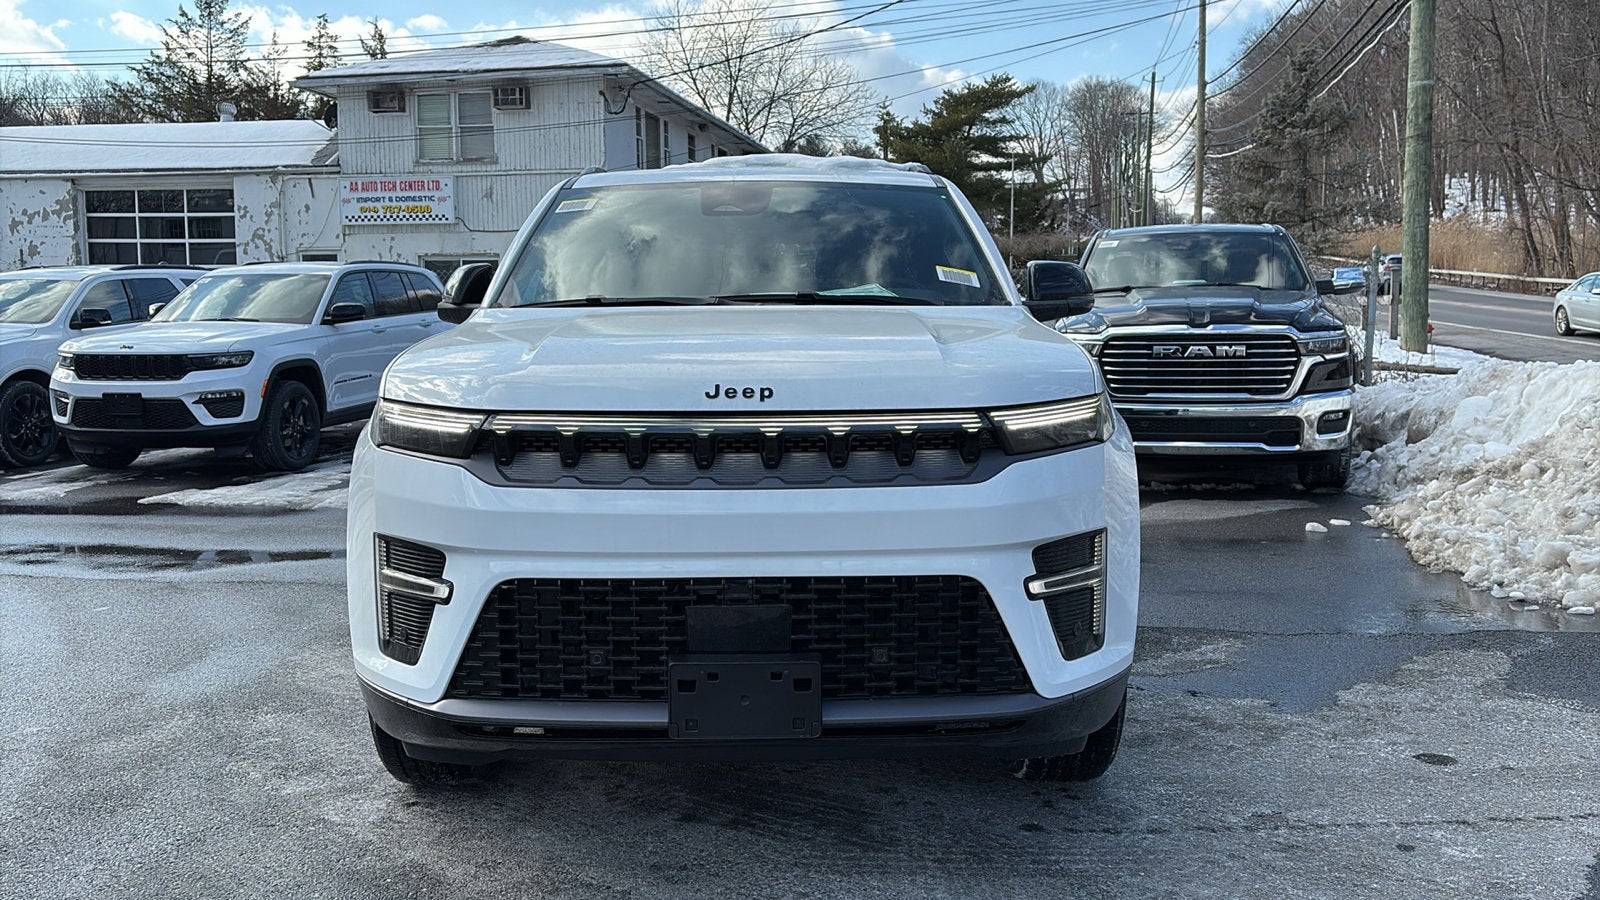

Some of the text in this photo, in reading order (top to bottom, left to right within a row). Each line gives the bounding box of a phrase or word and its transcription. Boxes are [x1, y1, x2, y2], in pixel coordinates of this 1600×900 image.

[349, 181, 359, 192] AA
[361, 181, 378, 192] AUTO
[380, 180, 397, 192] TECH
[400, 180, 425, 191] CENTER
[1152, 345, 1247, 357] RAM
[704, 383, 774, 402] Jeep
